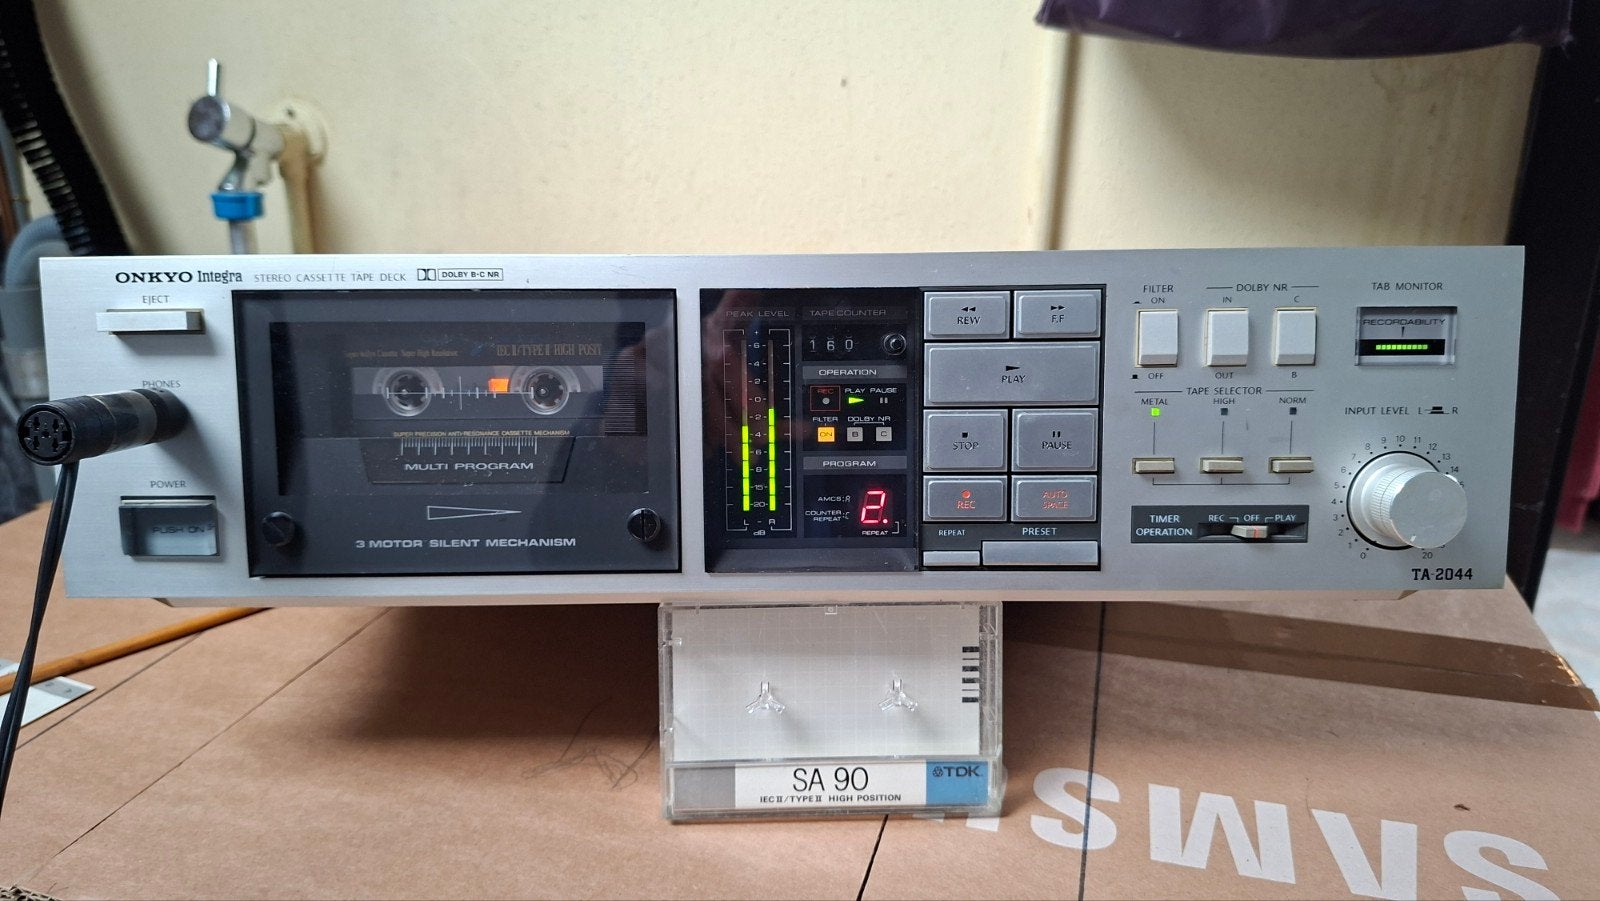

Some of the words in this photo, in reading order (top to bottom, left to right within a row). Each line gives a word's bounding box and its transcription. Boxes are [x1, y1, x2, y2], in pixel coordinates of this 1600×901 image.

[115, 272, 192, 283] ONKYO
[197, 270, 243, 284] Integra
[254, 274, 292, 282] STEREO
[296, 273, 346, 282] CASSETTE
[352, 273, 373, 282] TAPE
[380, 273, 406, 282] DECK
[1143, 285, 1173, 293] FILTER
[142, 295, 170, 305] EJECT
[957, 316, 980, 325] REW
[554, 344, 575, 355] HIGH
[1001, 375, 1025, 383] PLAY
[142, 380, 180, 388] PHONES
[1345, 407, 1375, 415] INPUT
[953, 442, 978, 450] STOP
[1042, 441, 1072, 449] PAUSE
[405, 463, 448, 471] MULTI
[150, 480, 187, 488] POWER
[1042, 490, 1068, 499] AUTO
[957, 501, 975, 509] REC
[1042, 501, 1069, 509] SPACE
[1150, 515, 1180, 523] TIMER
[1244, 514, 1260, 522] OFF
[1275, 514, 1296, 522] PLAY
[152, 526, 183, 534] PUSH
[1022, 528, 1057, 536] PRESET
[1136, 528, 1193, 536] OPERATION
[356, 540, 365, 548] 3
[369, 540, 423, 548] MOTOR
[429, 539, 480, 548] SILENT
[486, 538, 576, 547] MECHANISM
[943, 766, 980, 777] TDK
[793, 767, 825, 792] SA
[834, 766, 869, 791] 90
[829, 794, 853, 802] HIGH
[856, 794, 901, 802] POSITION
